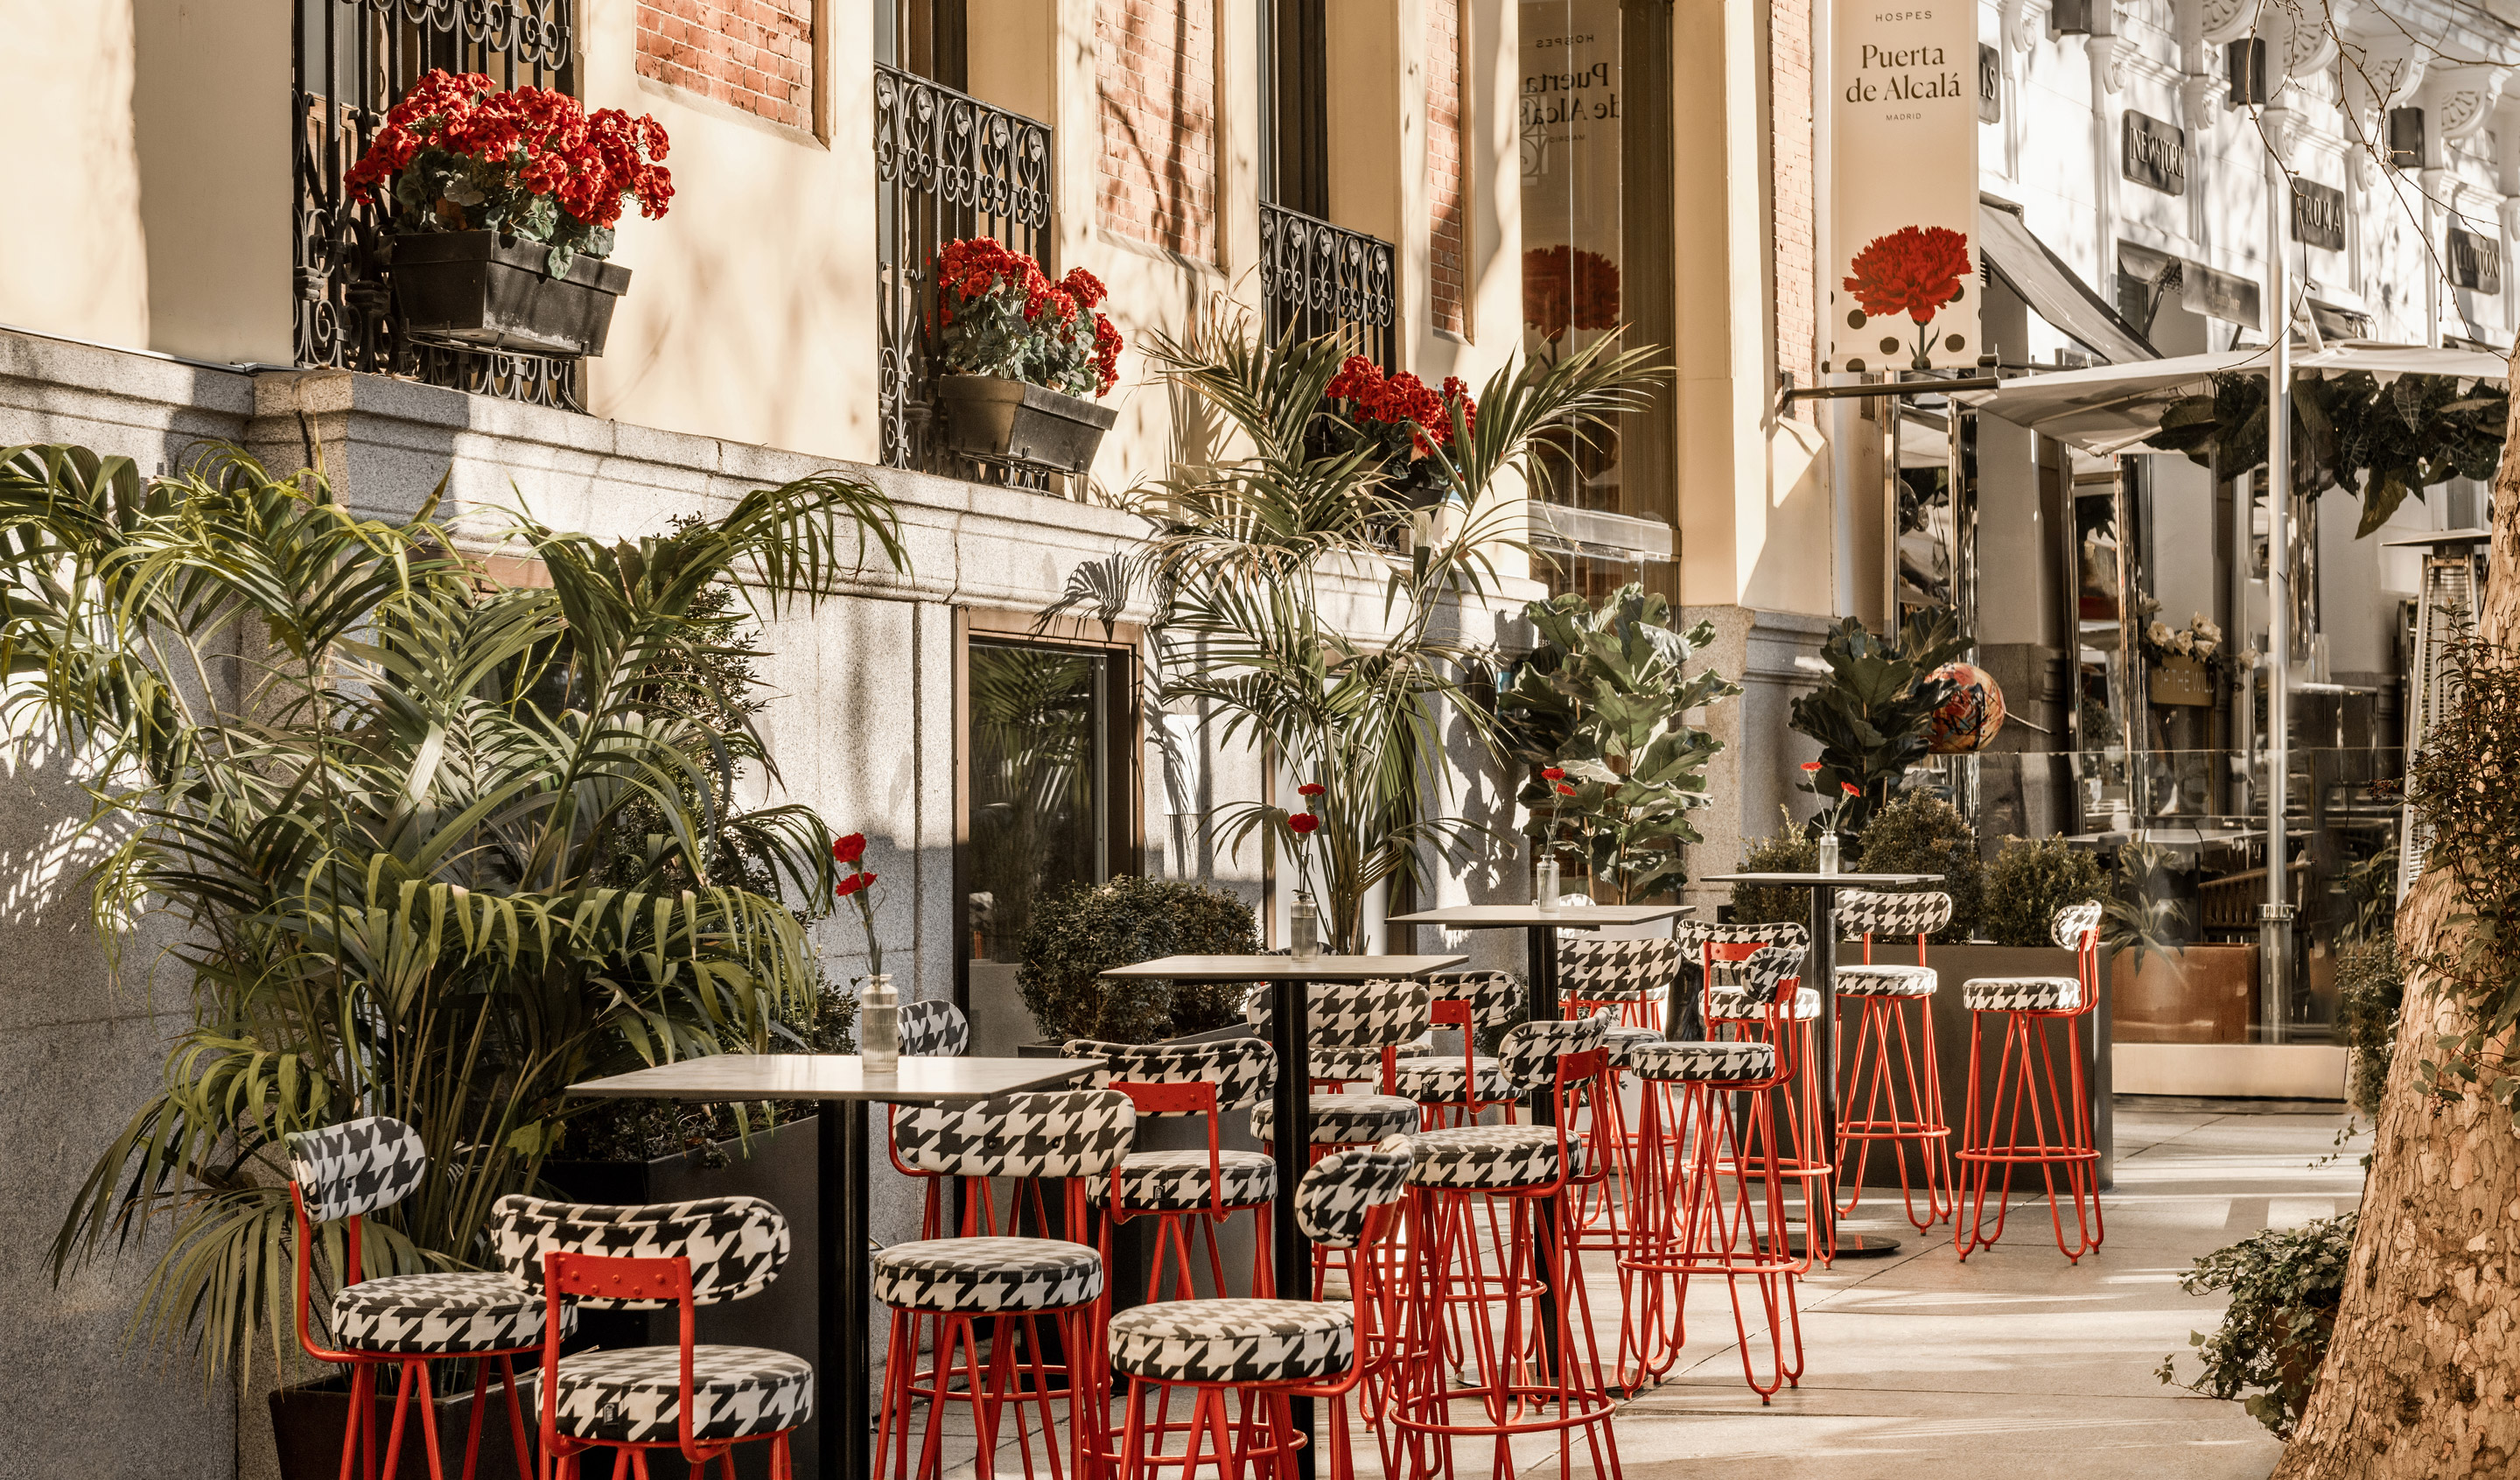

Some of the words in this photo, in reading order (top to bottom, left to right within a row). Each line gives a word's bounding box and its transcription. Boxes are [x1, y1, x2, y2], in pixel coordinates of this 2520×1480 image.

[1875, 11, 1932, 22] HOSPES
[1861, 44, 1945, 69] Puerta
[1845, 77, 1877, 103] de
[1883, 72, 1961, 101] Alcalá
[1886, 112, 1922, 121] MADRID
[2305, 195, 2342, 234] ROMA
[2172, 669, 2189, 692] THE
[2193, 671, 2216, 693] WILD
